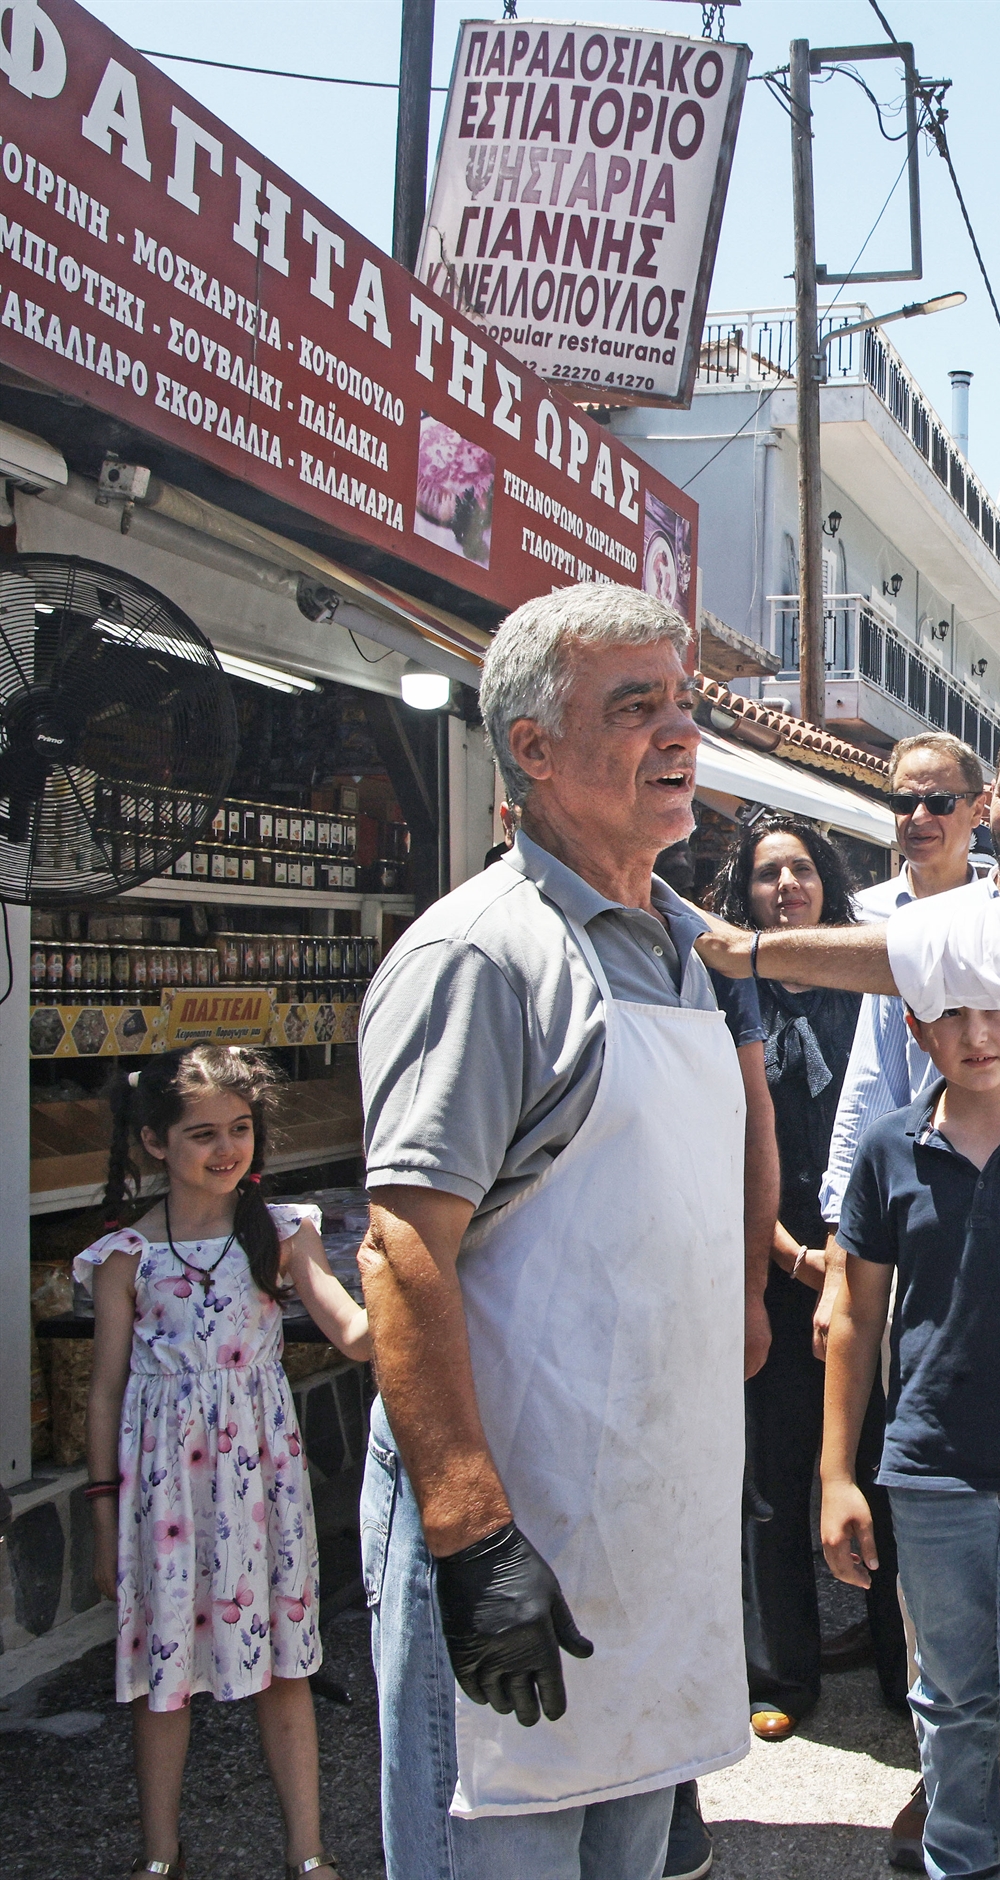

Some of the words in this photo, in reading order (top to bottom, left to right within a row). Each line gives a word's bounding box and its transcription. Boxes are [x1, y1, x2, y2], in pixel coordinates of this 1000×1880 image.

[464, 30, 724, 99] ΠΑΡΑΔΟΣΙΑΚΟ
[459, 81, 705, 161] ΕΣΤΙΑΤΟΡΙΟ
[465, 145, 676, 223] ΨΗΣΤΑΡΙΑ
[0, 0, 392, 349] ΦΑΓΗΤΑ
[409, 292, 523, 441] ΤΗΣ
[534, 398, 641, 525] ΩΡΑΣ
[454, 206, 664, 279] ΓΙΑΝΝΗΣ
[0, 136, 110, 244] ΟΙΡΙΝΗ
[133, 227, 282, 352] ΜΟΣΧΑΡΙΣΙΑ
[299, 334, 405, 427] ΚΟΤΟΠΟΥΛΟ
[552, 363, 600, 382] 22270
[604, 371, 655, 390] 41270
[558, 333, 676, 366] restaurand
[0, 285, 148, 397] ΑΚΑΛΙΑΡΟ
[155, 371, 283, 470] ΣΚΟΡΔΑΛΙΑ
[299, 450, 404, 532] ΚΑΛΑΜΑΡΙΑ
[168, 317, 284, 412] ΣΟΥΒΛΑΚΙ
[299, 394, 389, 472] ΠΑΪΔΑΚΙΑ
[503, 469, 584, 540] ΤΗΓΑΝΟΨΩΜΟ
[585, 522, 637, 573] ΧΩΡΙΑΤΙΚΟ
[521, 527, 576, 578] ΓΙΑΟΥΡΤΙ
[577, 559, 593, 582] ΜΕ
[37, 734, 64, 744] Primo
[180, 998, 262, 1022] ΠΑΣΤΕΛΙ
